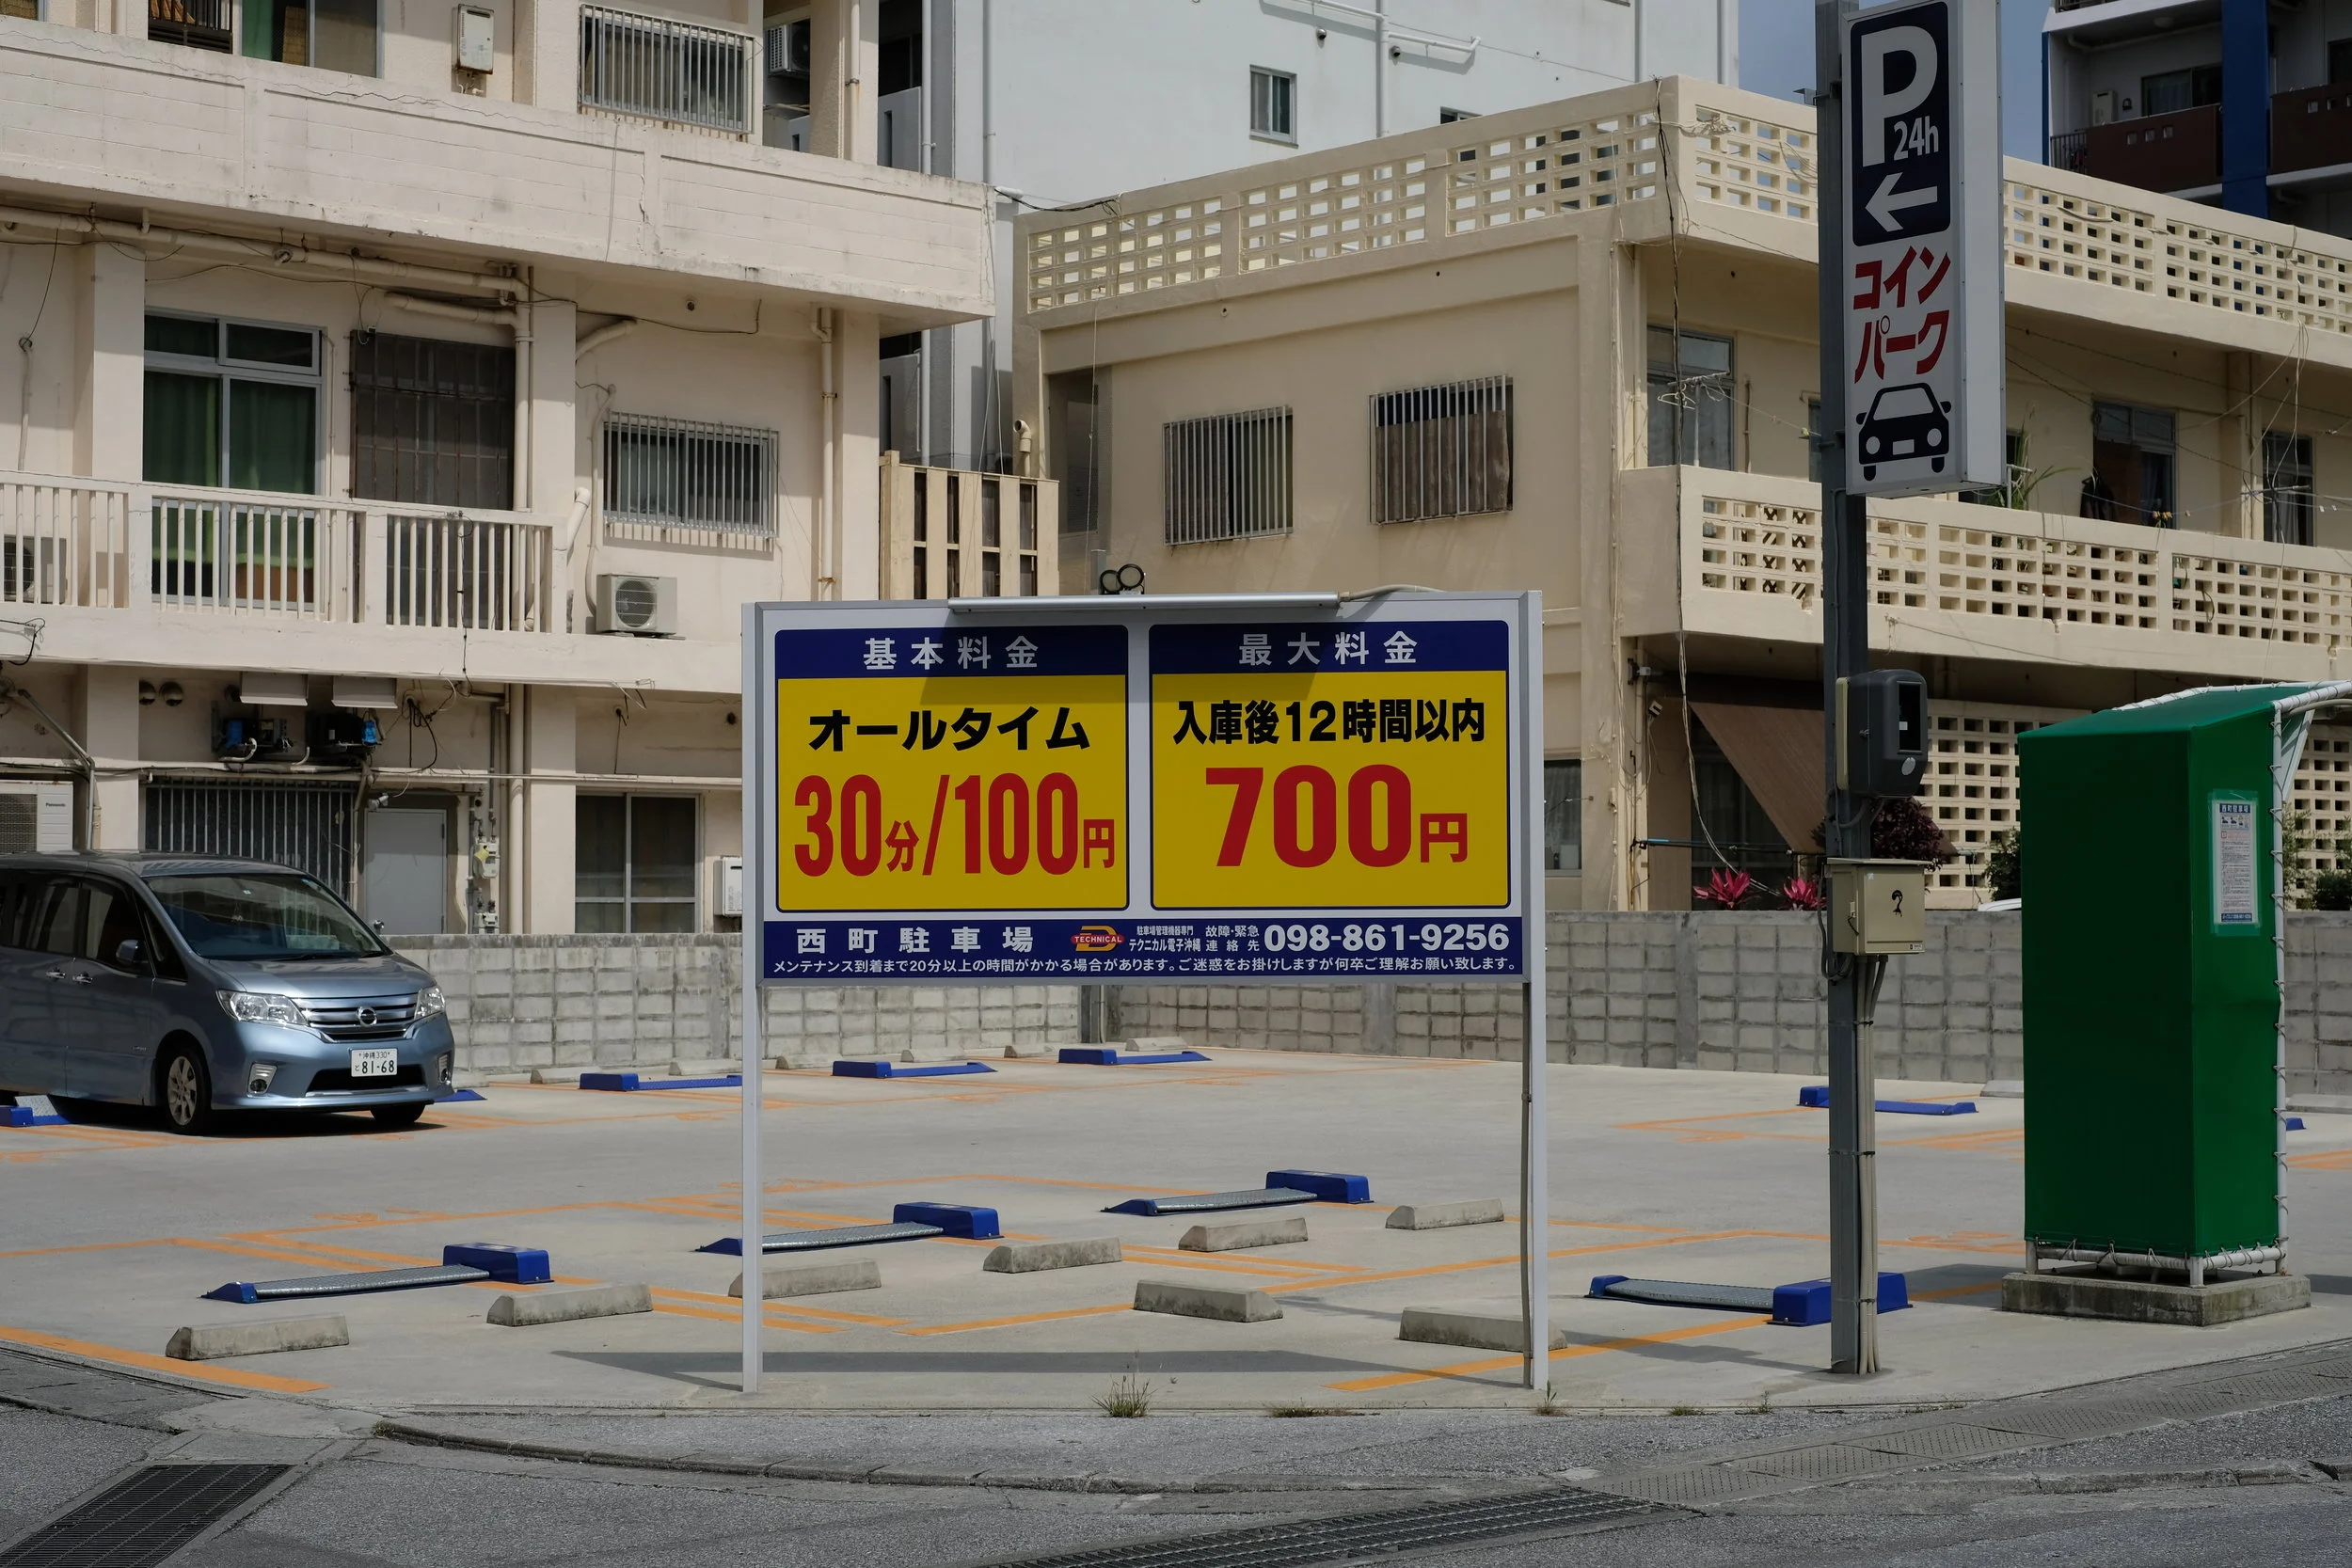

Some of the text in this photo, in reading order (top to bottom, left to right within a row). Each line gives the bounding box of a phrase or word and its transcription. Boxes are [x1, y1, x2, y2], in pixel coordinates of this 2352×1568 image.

[1861, 25, 1938, 167] P
[1893, 115, 1939, 161] 24h
[1852, 245, 1951, 310] コイン
[1854, 309, 1950, 384] パーク
[863, 635, 1039, 671] 基本料金
[1238, 630, 1418, 666] 最大料金
[809, 705, 1090, 752] オールタイム
[1172, 698, 1485, 745] 入庫後12時間以内
[794, 772, 1116, 877] 30分/100円
[1205, 764, 1468, 868] 700円
[797, 927, 1034, 954] 西町駐車場
[1205, 939, 1260, 952] 連絡先
[1263, 924, 1510, 952] 098-861-9256
[362, 1060, 394, 1074] 81-68
